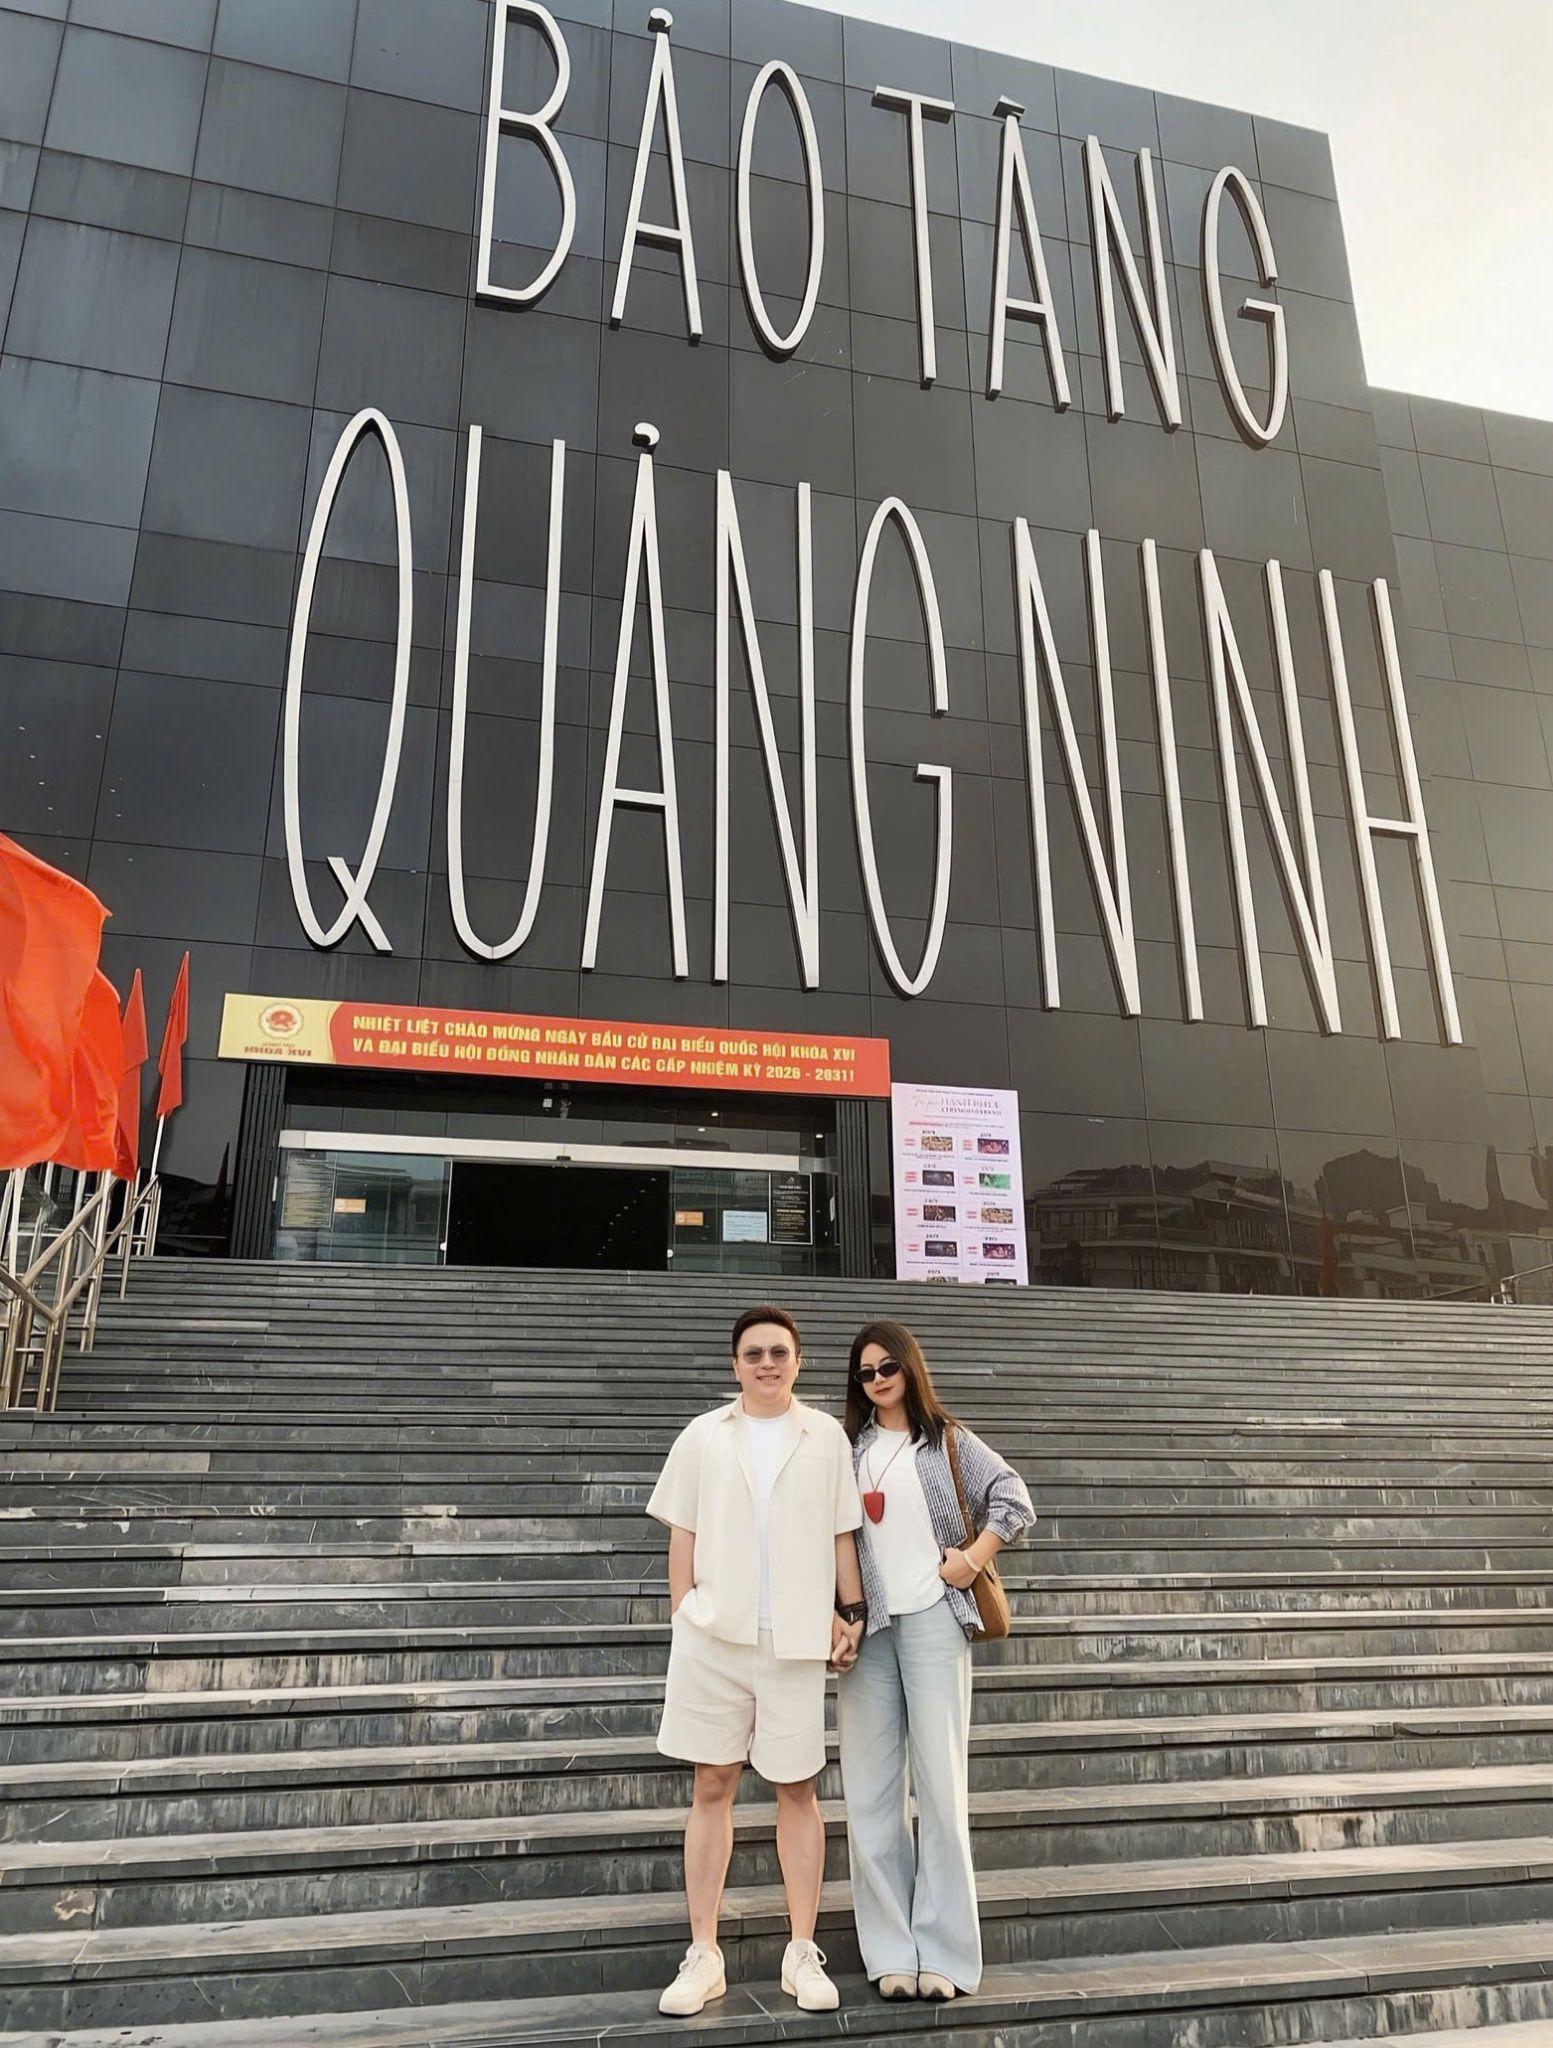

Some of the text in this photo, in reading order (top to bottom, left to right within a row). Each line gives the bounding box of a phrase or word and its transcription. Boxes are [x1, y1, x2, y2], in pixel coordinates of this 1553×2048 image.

[475, 0, 1288, 443] BẢO TÀNG
[283, 407, 1463, 1045] QUẢNG NINH
[352, 1037, 374, 1052] VÀ
[378, 1039, 407, 1057] ĐẠI
[411, 1039, 449, 1058] BIỂU
[454, 1043, 482, 1061] HỘI
[535, 1050, 579, 1067] NHÂN
[584, 1053, 617, 1069] DÂN
[621, 1055, 651, 1071] CÁC
[656, 1057, 686, 1073] CẤP
[690, 1060, 738, 1078] NHIỆM
[766, 1065, 801, 1080] 2026
[815, 1068, 855, 1082] 2031!
[353, 1016, 401, 1034] NHIỆT
[407, 1018, 439, 1036] LIỆT
[445, 1022, 488, 1038] CHÀO
[493, 1025, 540, 1042] MỪNG
[545, 1029, 588, 1045] NGÀY
[627, 1033, 648, 1049] CỬ
[651, 1037, 677, 1054] ĐẠI
[681, 1036, 715, 1053] BIỂU
[719, 1039, 758, 1056] QUỐC
[762, 1043, 786, 1060] HỘI
[790, 1045, 829, 1060] KHÓA
[833, 1048, 856, 1061] XVI
